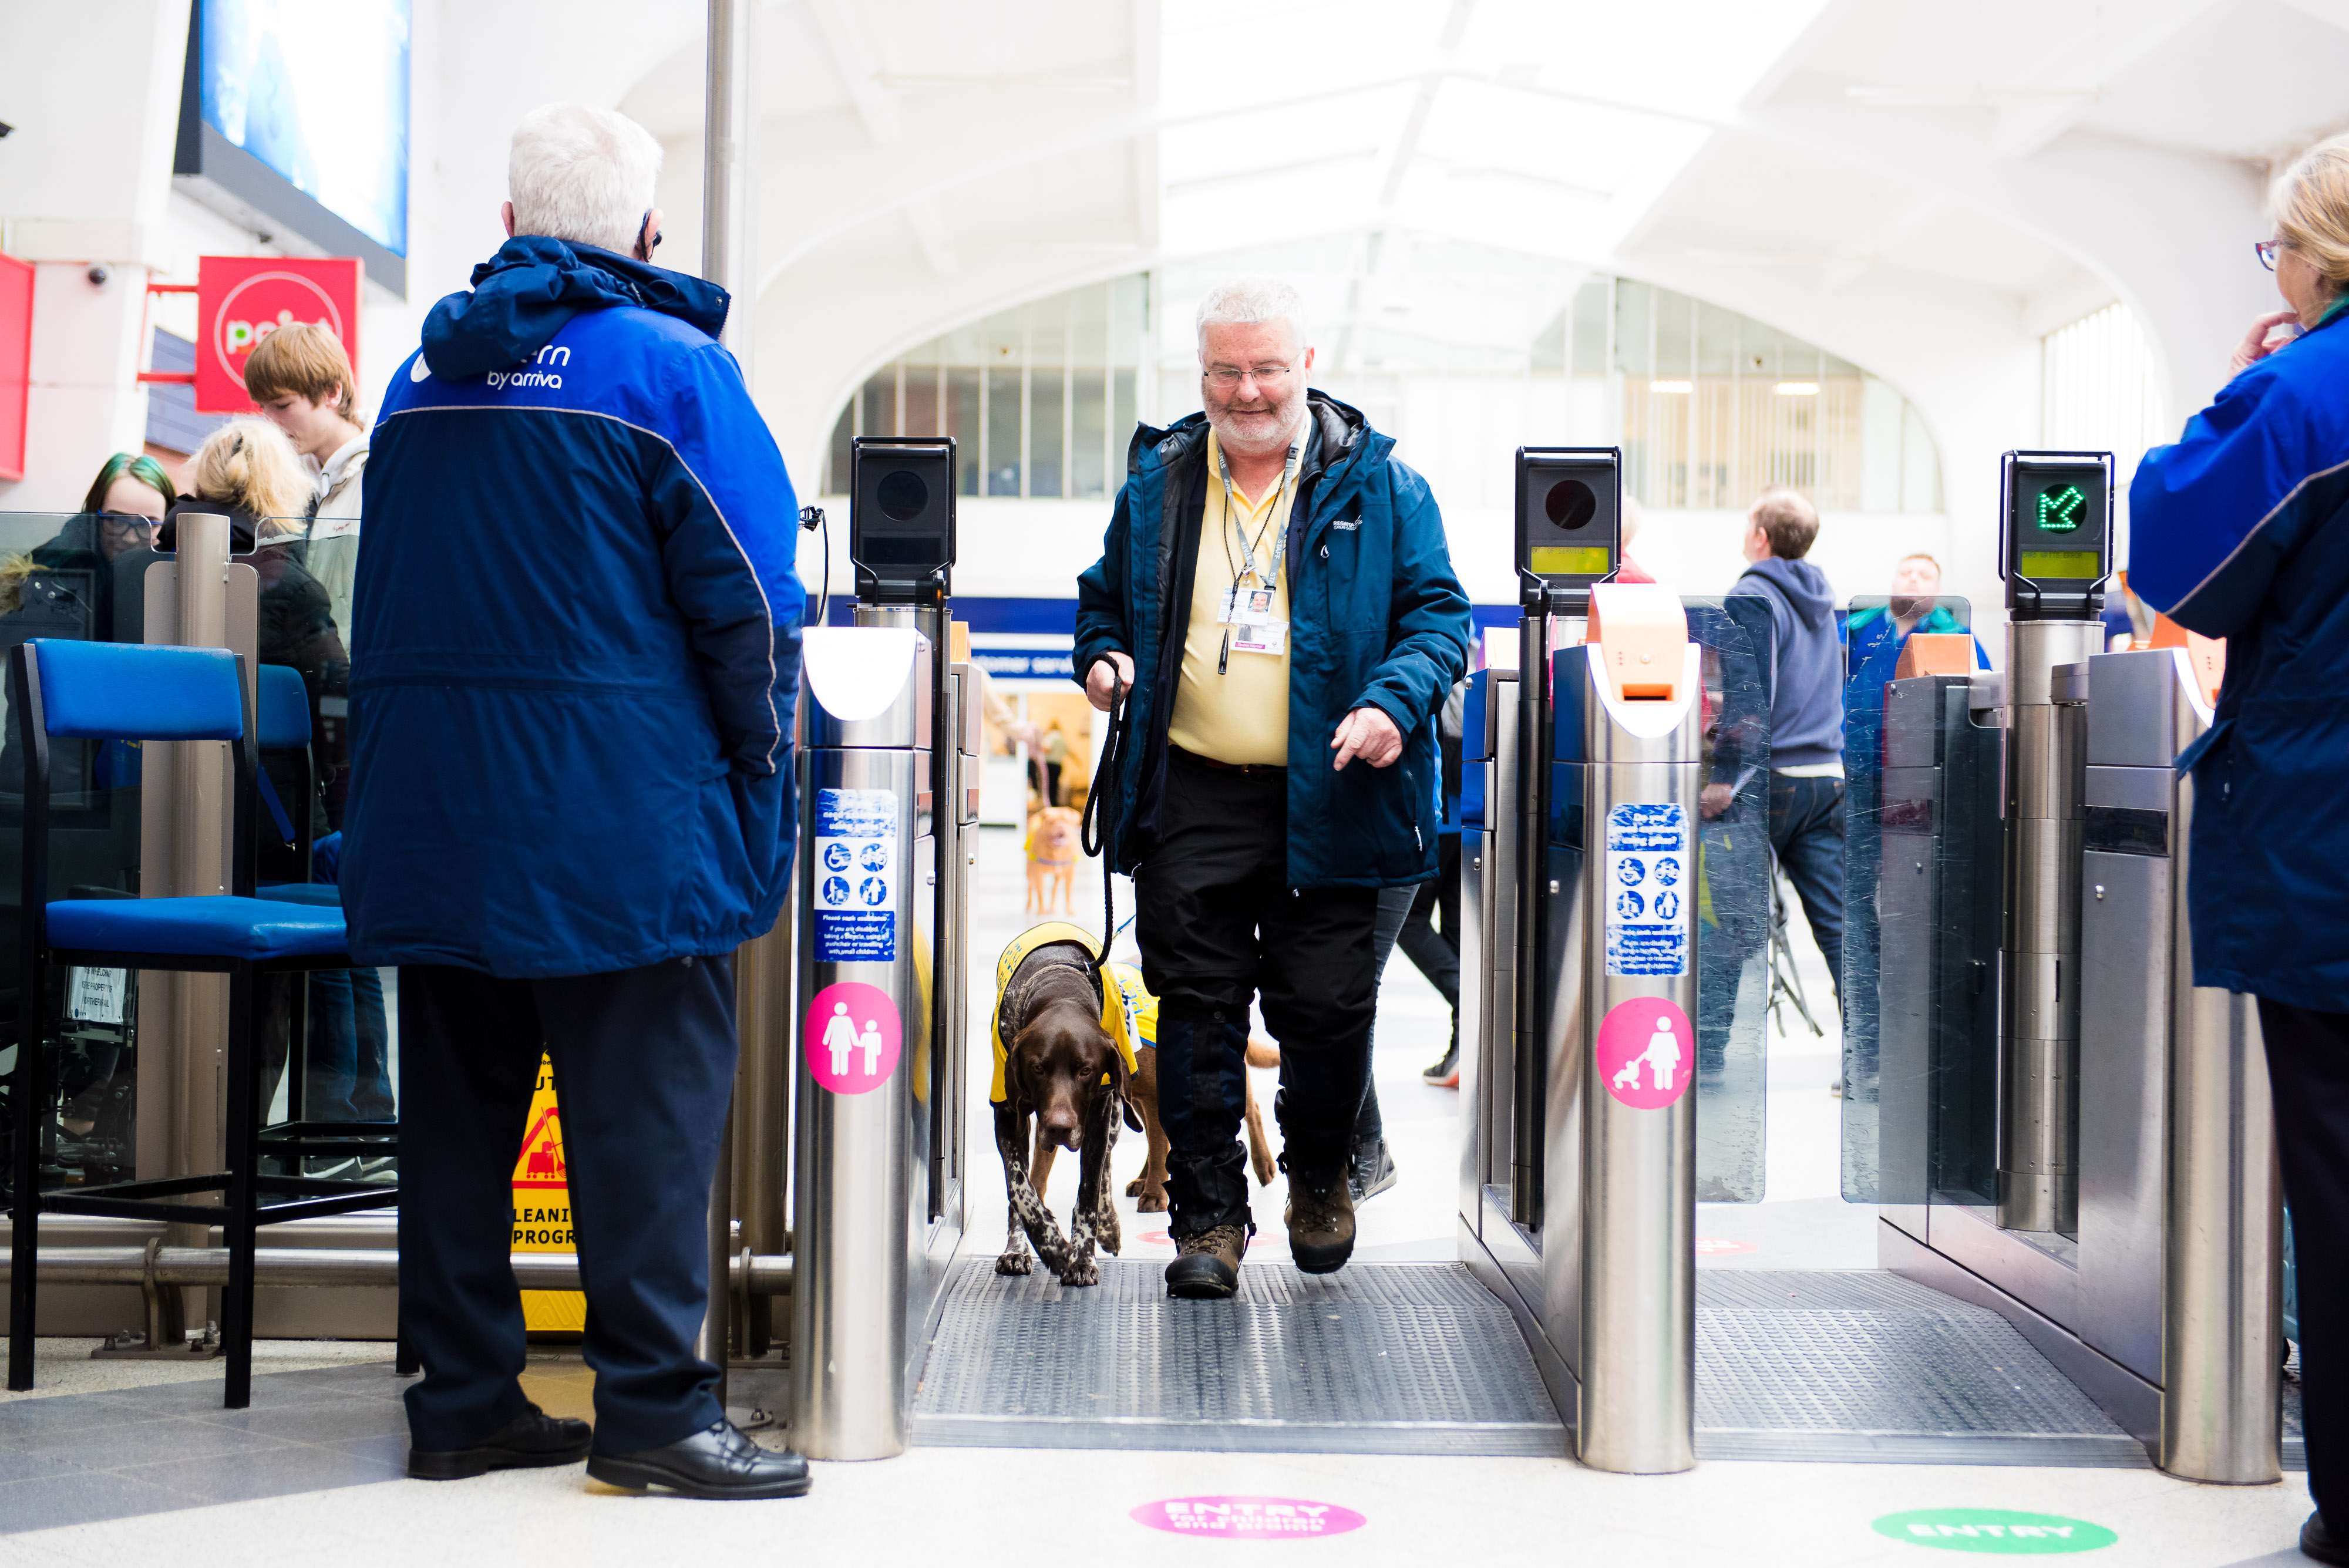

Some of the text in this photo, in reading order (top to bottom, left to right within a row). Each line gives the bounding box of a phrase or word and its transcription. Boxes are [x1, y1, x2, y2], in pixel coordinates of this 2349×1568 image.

[487, 371, 562, 390] by arriva
[1274, 539, 1283, 560] STAFF
[513, 1208, 569, 1222] LEANI
[513, 1230, 576, 1244] PROGR
[1165, 1502, 1329, 1517] ENTRY
[1906, 1524, 2074, 1538] ENTRY
